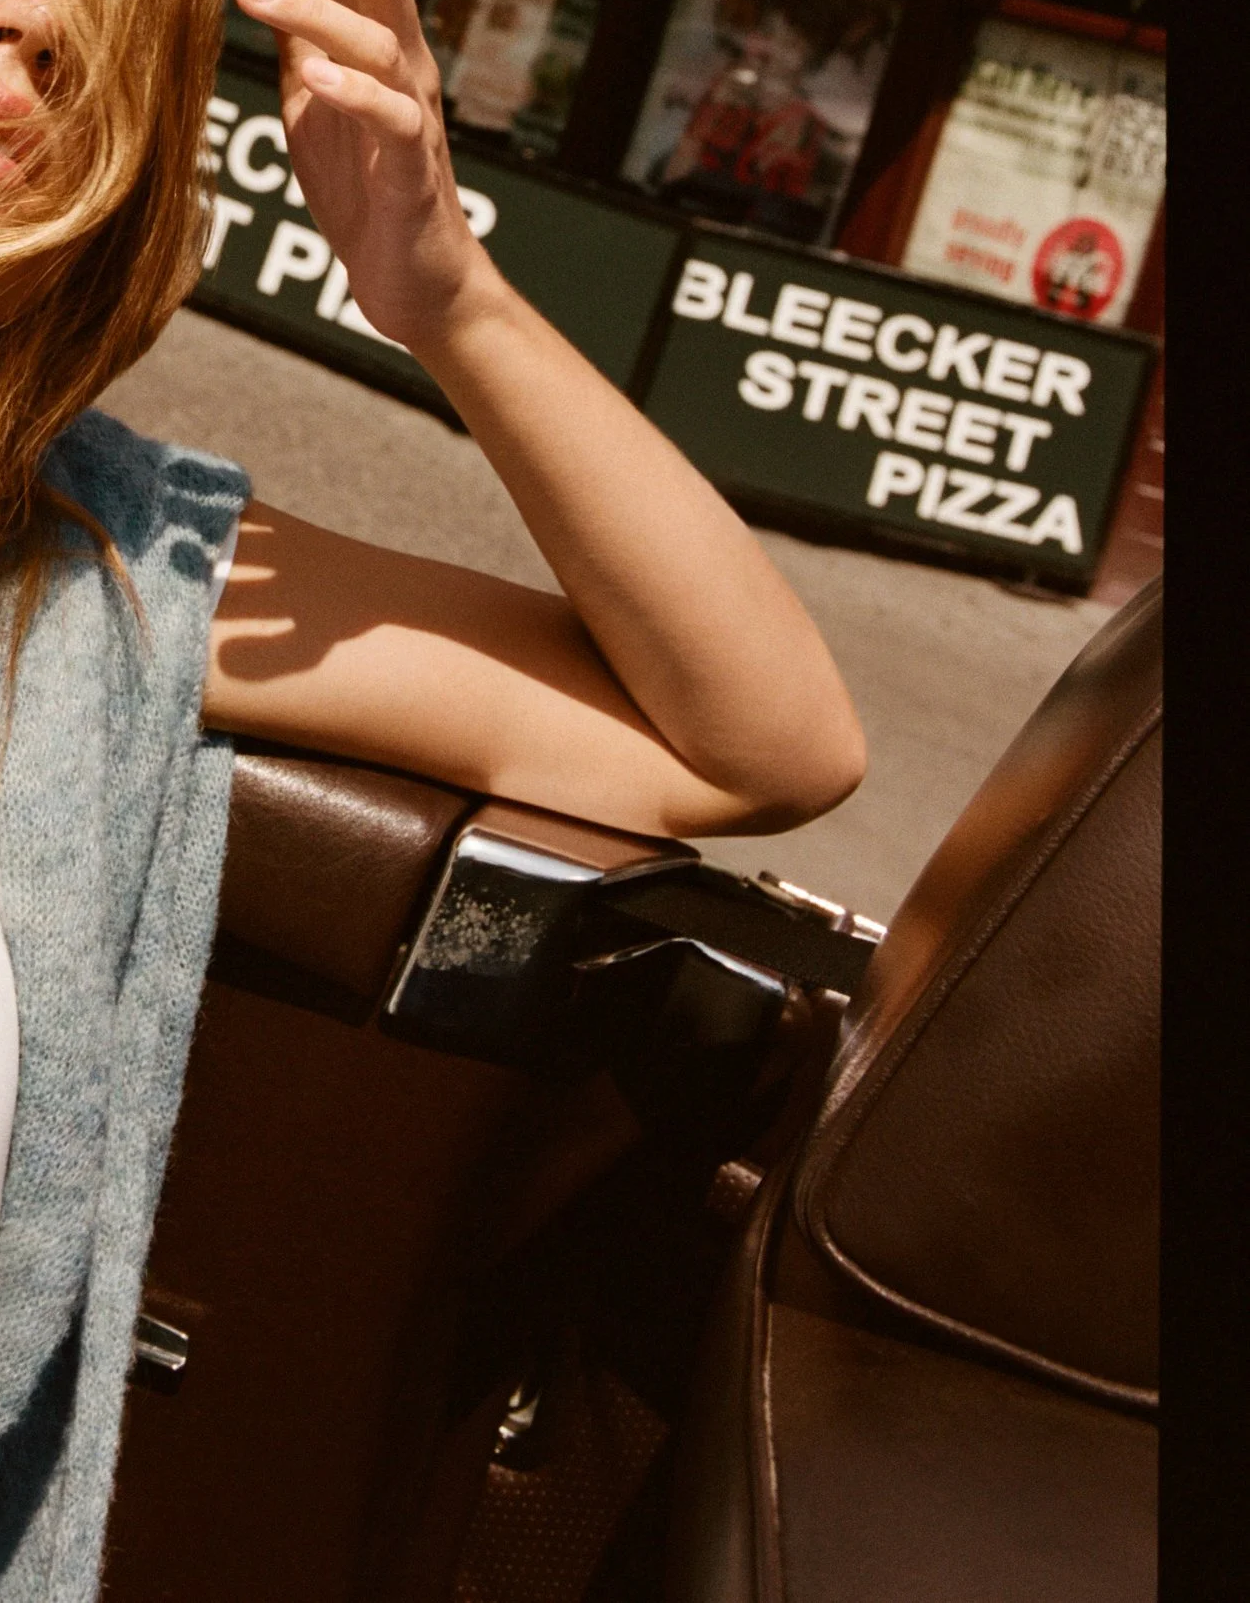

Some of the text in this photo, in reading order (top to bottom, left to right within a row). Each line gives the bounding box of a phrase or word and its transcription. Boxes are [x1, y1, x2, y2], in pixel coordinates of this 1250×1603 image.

[672, 259, 1092, 416] BLEECKER
[738, 350, 1053, 473] STREET
[866, 450, 1084, 555] PIZZA
